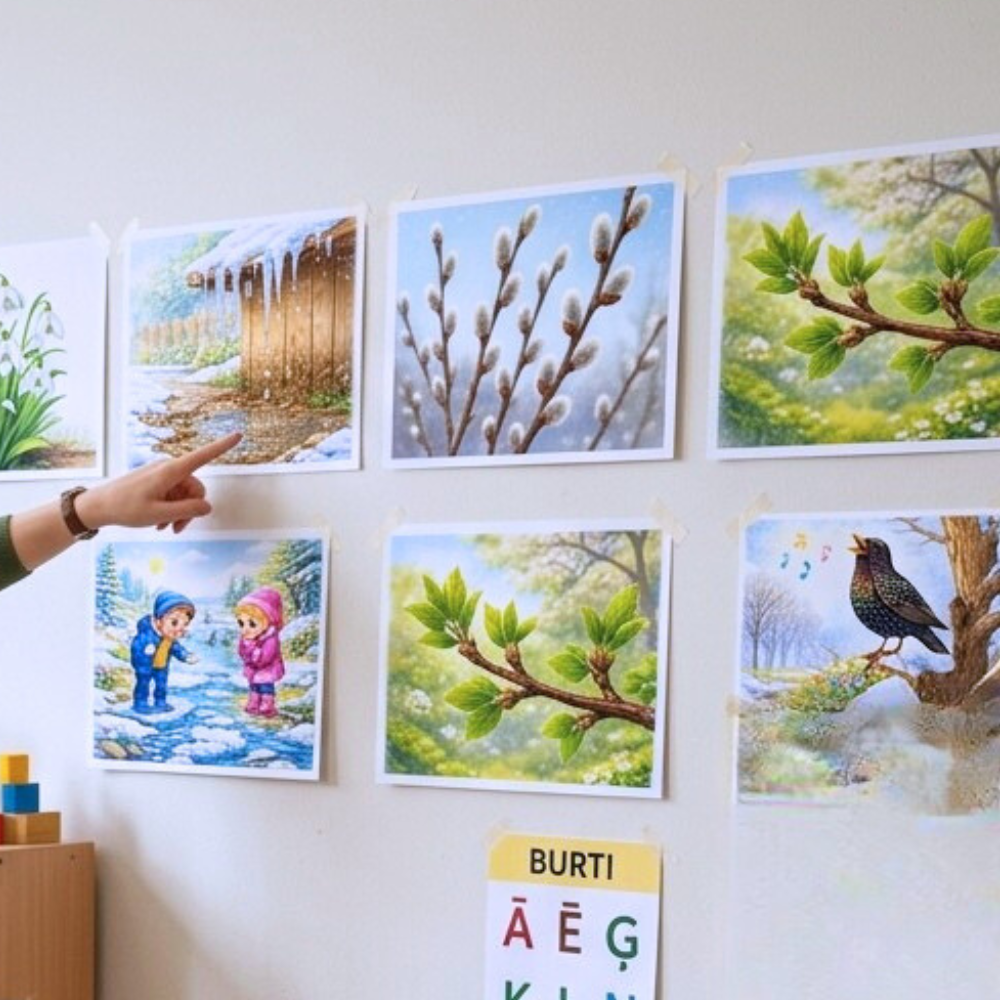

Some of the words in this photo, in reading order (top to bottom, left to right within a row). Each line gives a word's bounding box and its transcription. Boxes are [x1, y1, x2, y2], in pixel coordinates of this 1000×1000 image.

[530, 848, 613, 880] BURTI
[503, 897, 534, 949] Ā
[558, 902, 582, 954] Ē
[606, 916, 638, 972] Ģ
